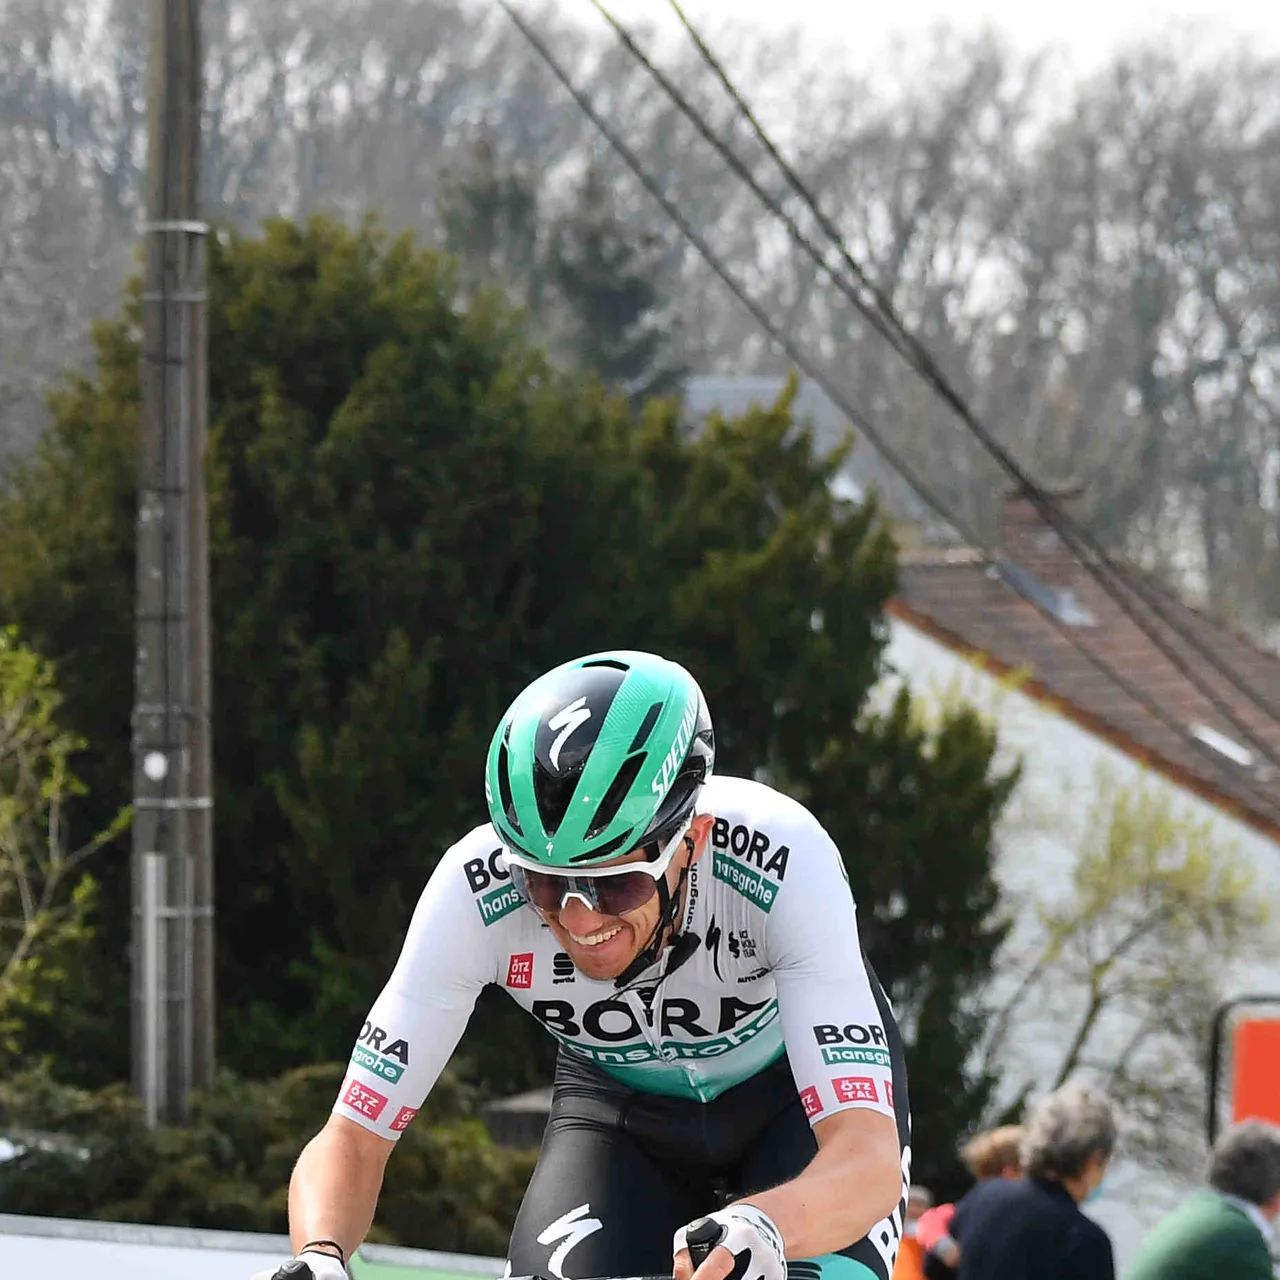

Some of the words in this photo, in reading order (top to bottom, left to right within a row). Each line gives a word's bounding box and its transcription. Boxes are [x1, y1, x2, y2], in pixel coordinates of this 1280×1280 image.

[711, 816, 791, 882] BORA
[511, 957, 530, 974] ÖTZ
[510, 974, 528, 985] TAL
[532, 996, 776, 1042] BORA
[840, 1080, 872, 1092] ÖTZ
[842, 1090, 874, 1100] TAL
[346, 1094, 373, 1116] TAL
[351, 1084, 380, 1108] ÖTZ
